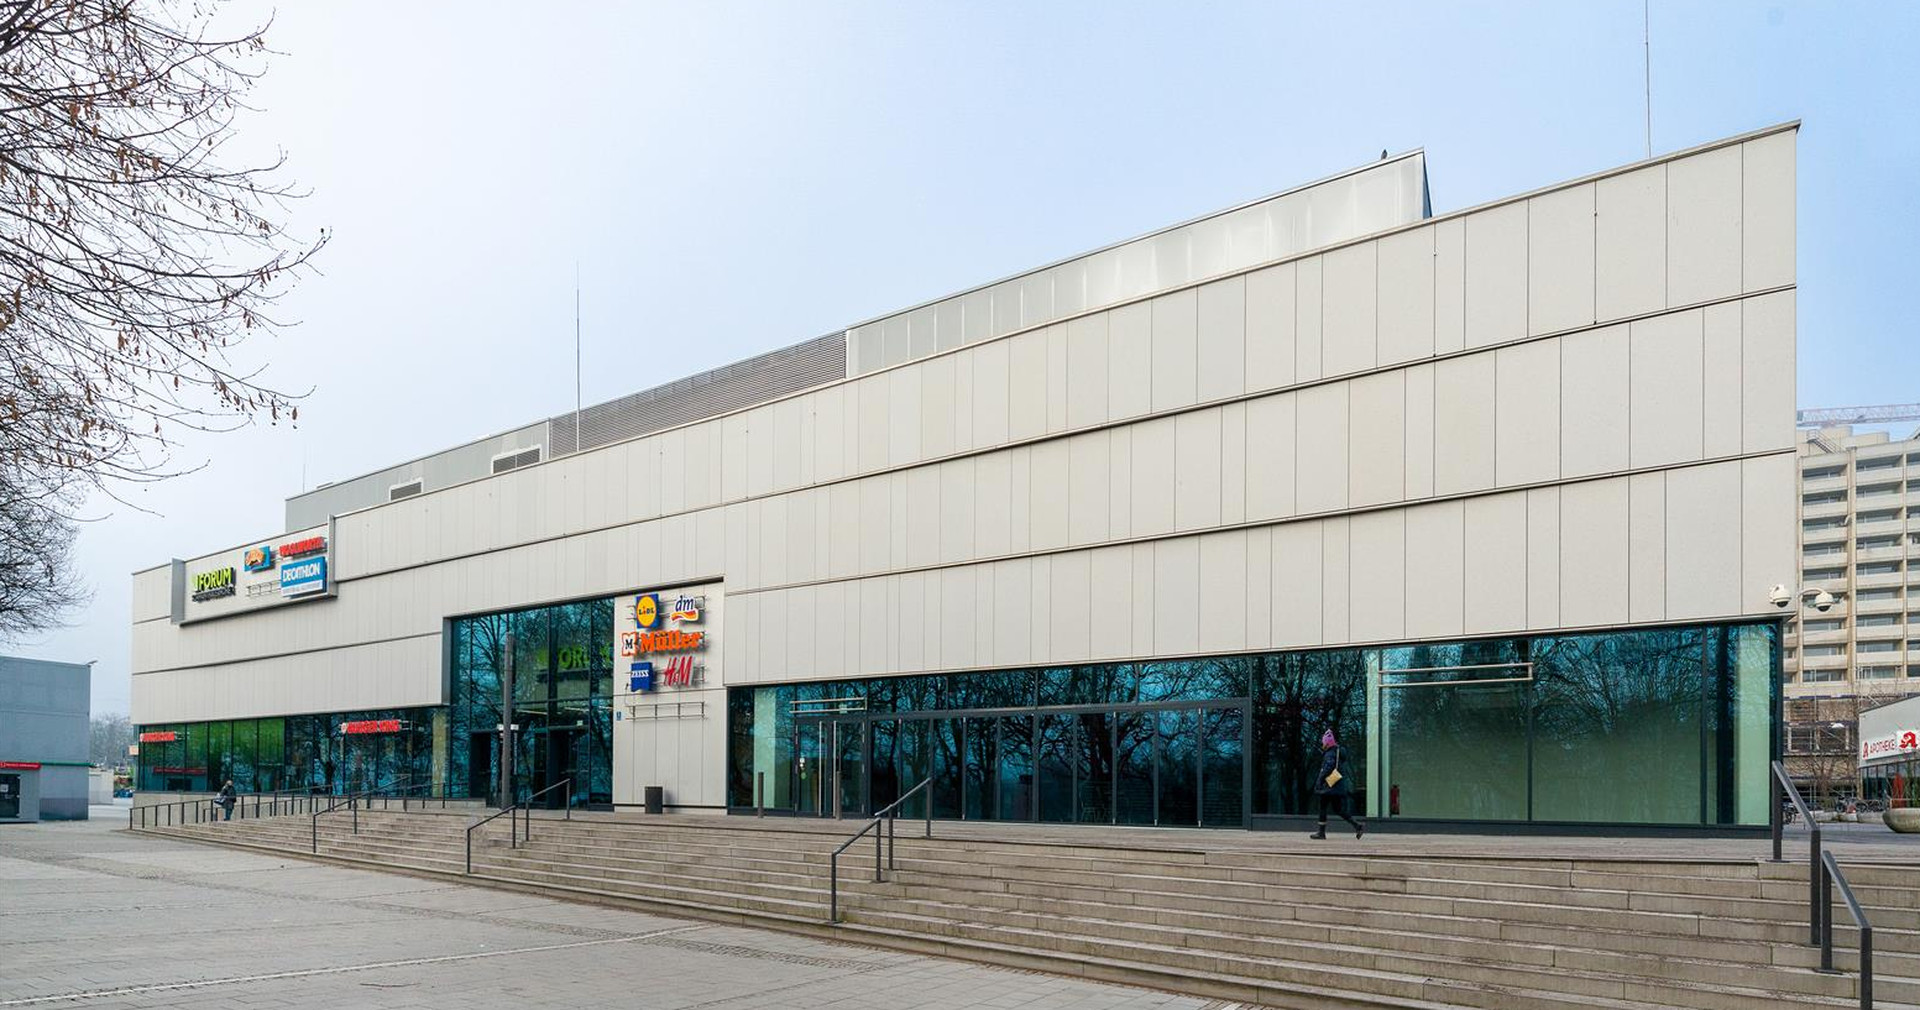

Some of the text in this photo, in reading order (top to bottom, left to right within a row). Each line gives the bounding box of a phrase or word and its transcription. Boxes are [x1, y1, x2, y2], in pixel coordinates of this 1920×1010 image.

[199, 566, 232, 592] FORUM
[282, 562, 321, 582] DECATHLON
[675, 595, 694, 612] dm
[640, 630, 702, 652] Müller
[631, 669, 649, 678] ZEISS
[664, 655, 693, 688] H&M
